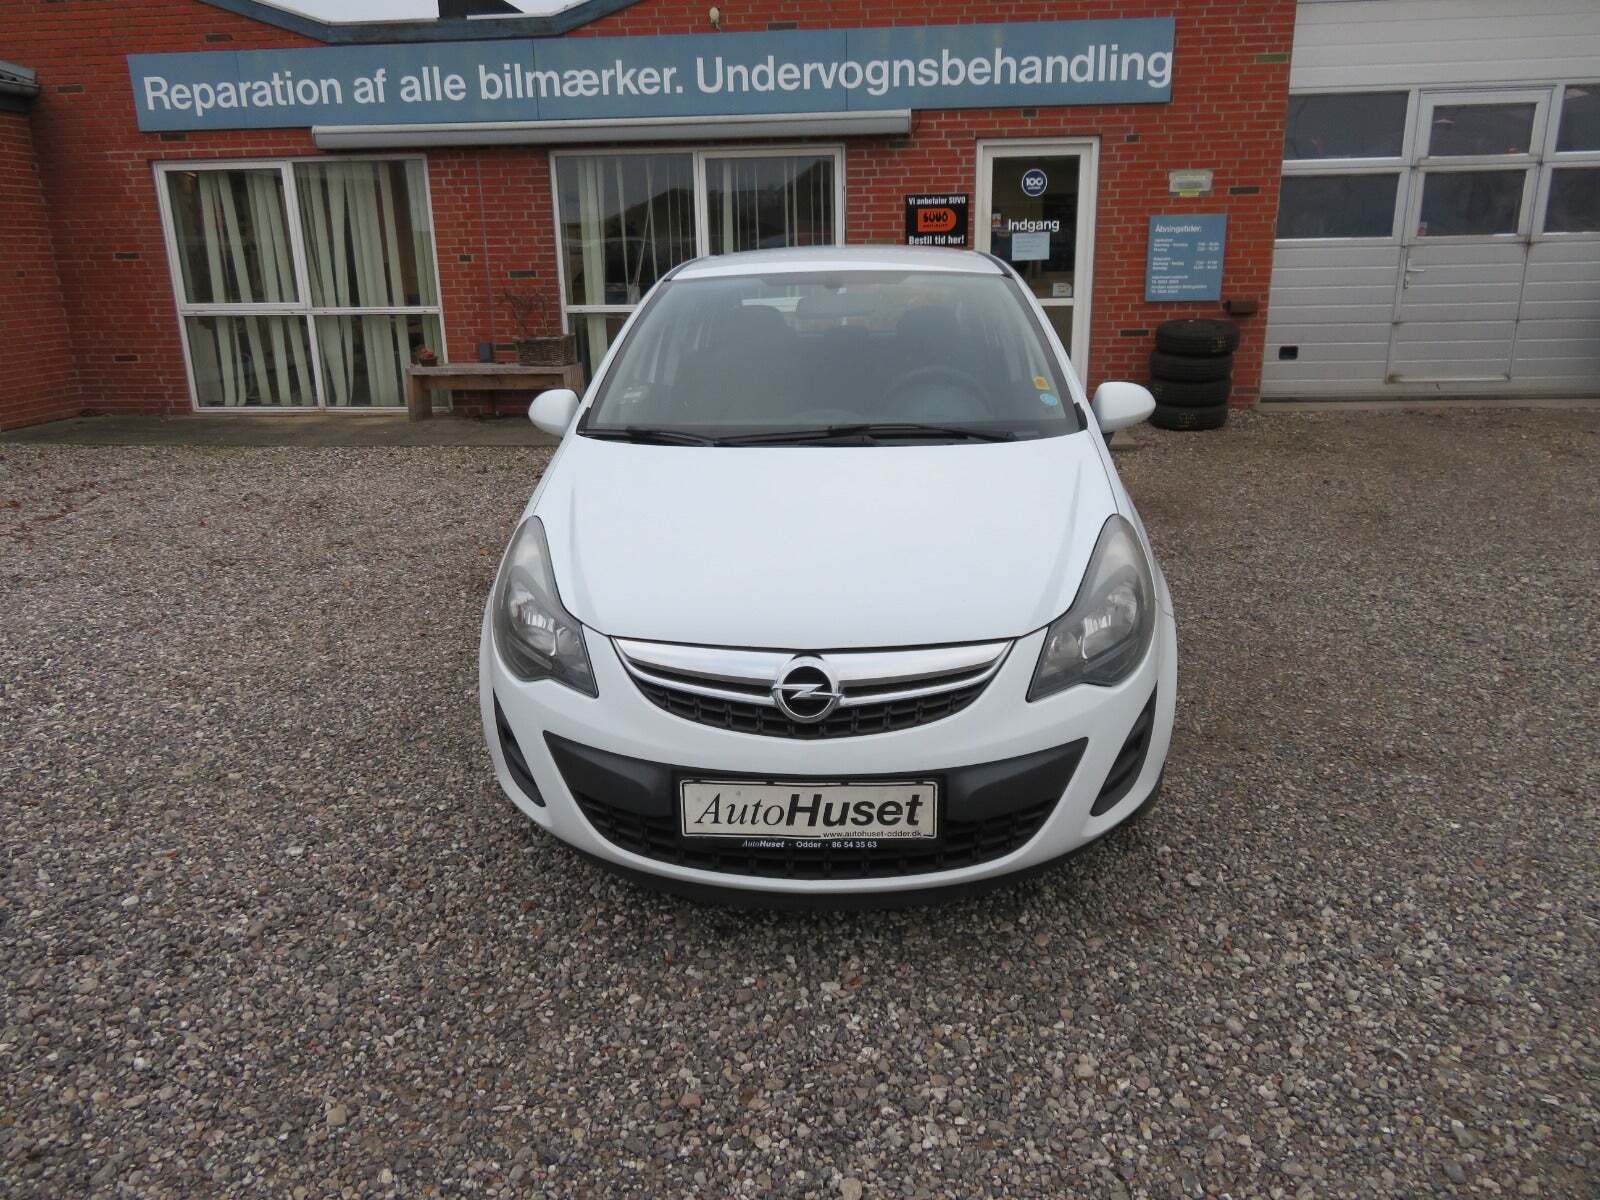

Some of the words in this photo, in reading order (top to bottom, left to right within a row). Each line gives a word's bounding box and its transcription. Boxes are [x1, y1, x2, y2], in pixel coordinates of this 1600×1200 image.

[143, 70, 342, 116] Reparation
[353, 68, 386, 104] af
[400, 66, 466, 101] alle
[478, 60, 683, 100] bilmærker.
[696, 44, 1172, 96] Undervognsbehandling
[1008, 218, 1060, 232] Indgang
[909, 236, 933, 245] Bestil
[934, 235, 946, 245] tid
[948, 235, 965, 245] her!
[694, 793, 923, 827] AutoHuset
[822, 830, 922, 838] www.autohuset-odder.dk
[742, 840, 785, 848] AutoHuset
